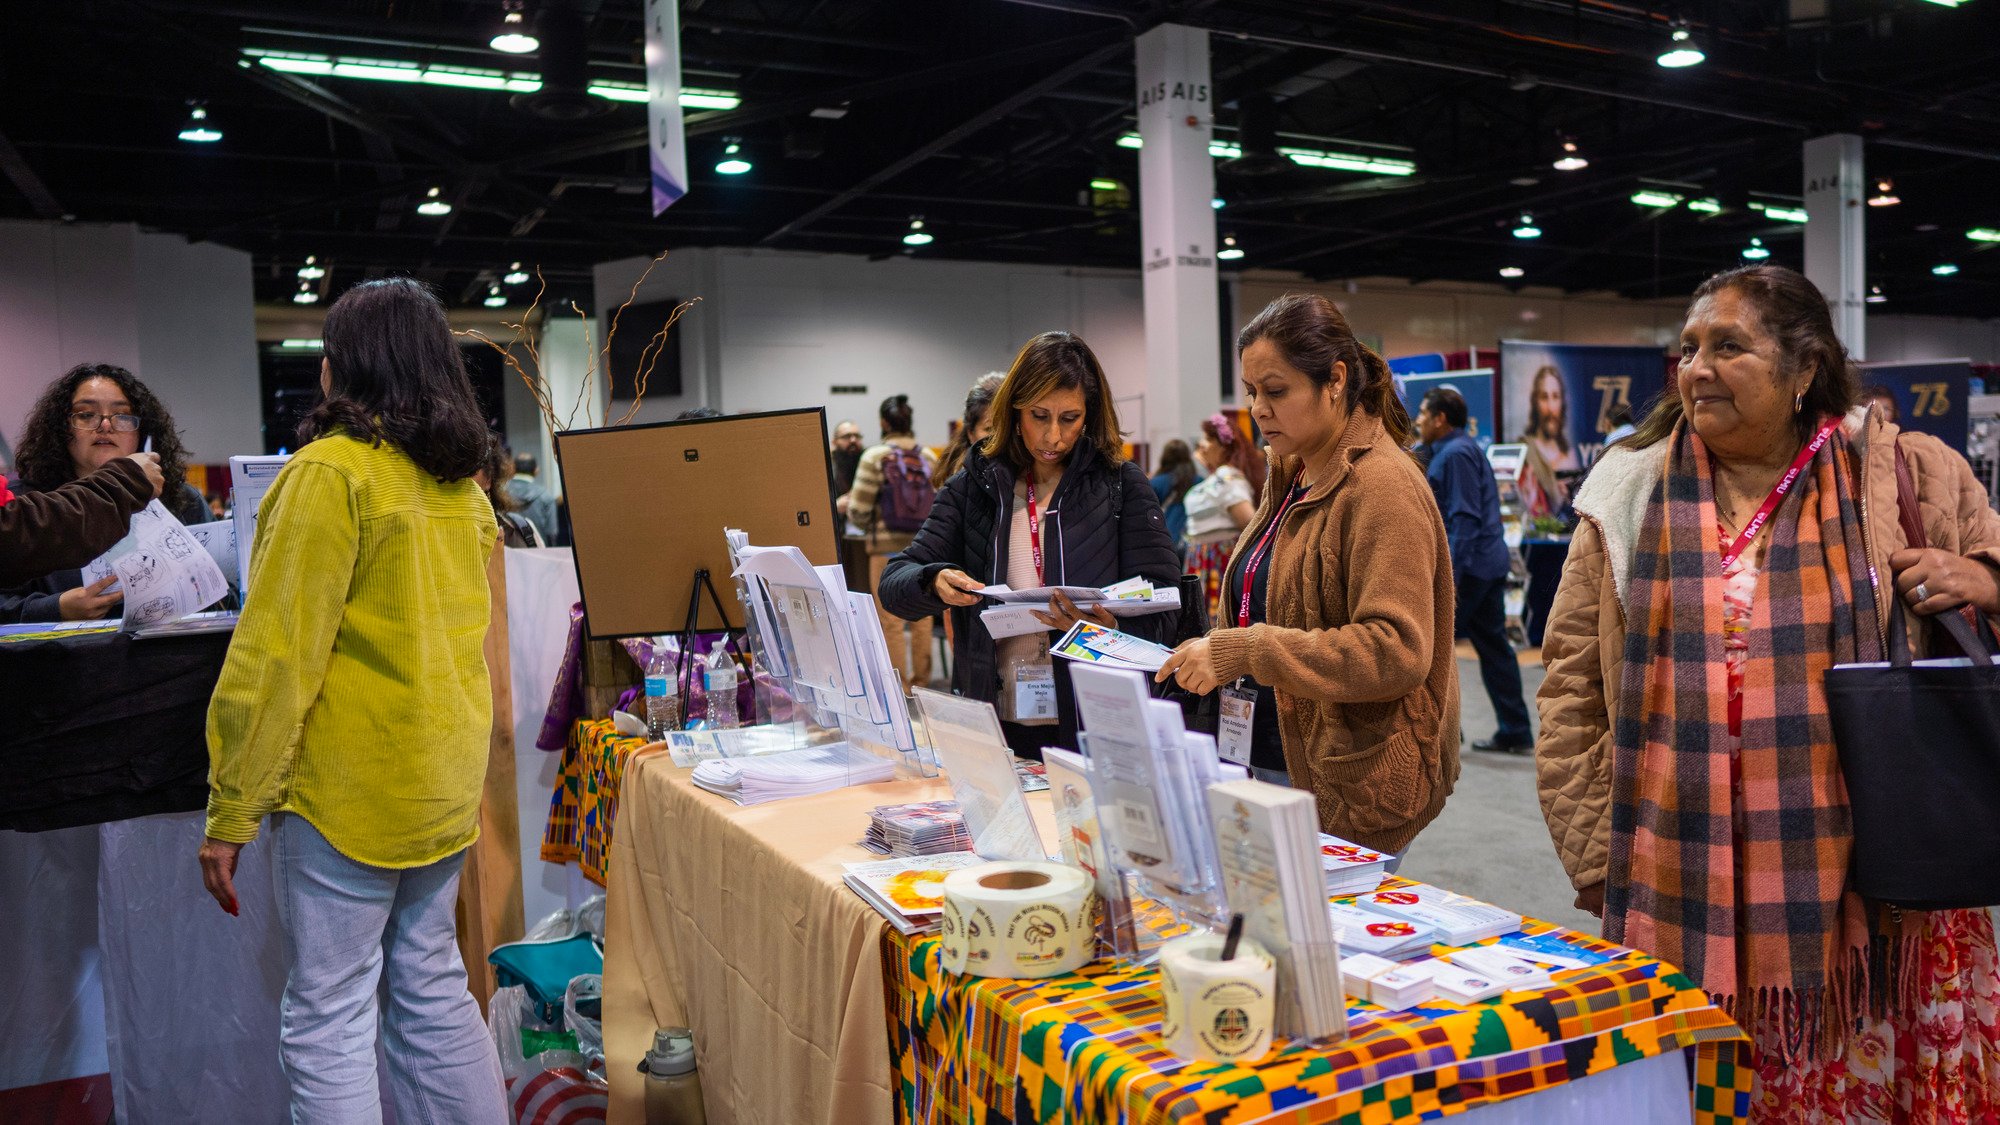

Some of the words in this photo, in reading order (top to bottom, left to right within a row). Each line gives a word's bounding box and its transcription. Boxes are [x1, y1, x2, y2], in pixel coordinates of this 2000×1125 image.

[1172, 81, 1208, 102] A15
[1910, 383, 1950, 417] 73
[1809, 433, 1828, 452] LMU
[1776, 474, 1794, 495] LMU
[1744, 519, 1763, 539] LMU
[1239, 598, 1247, 618] LMU
